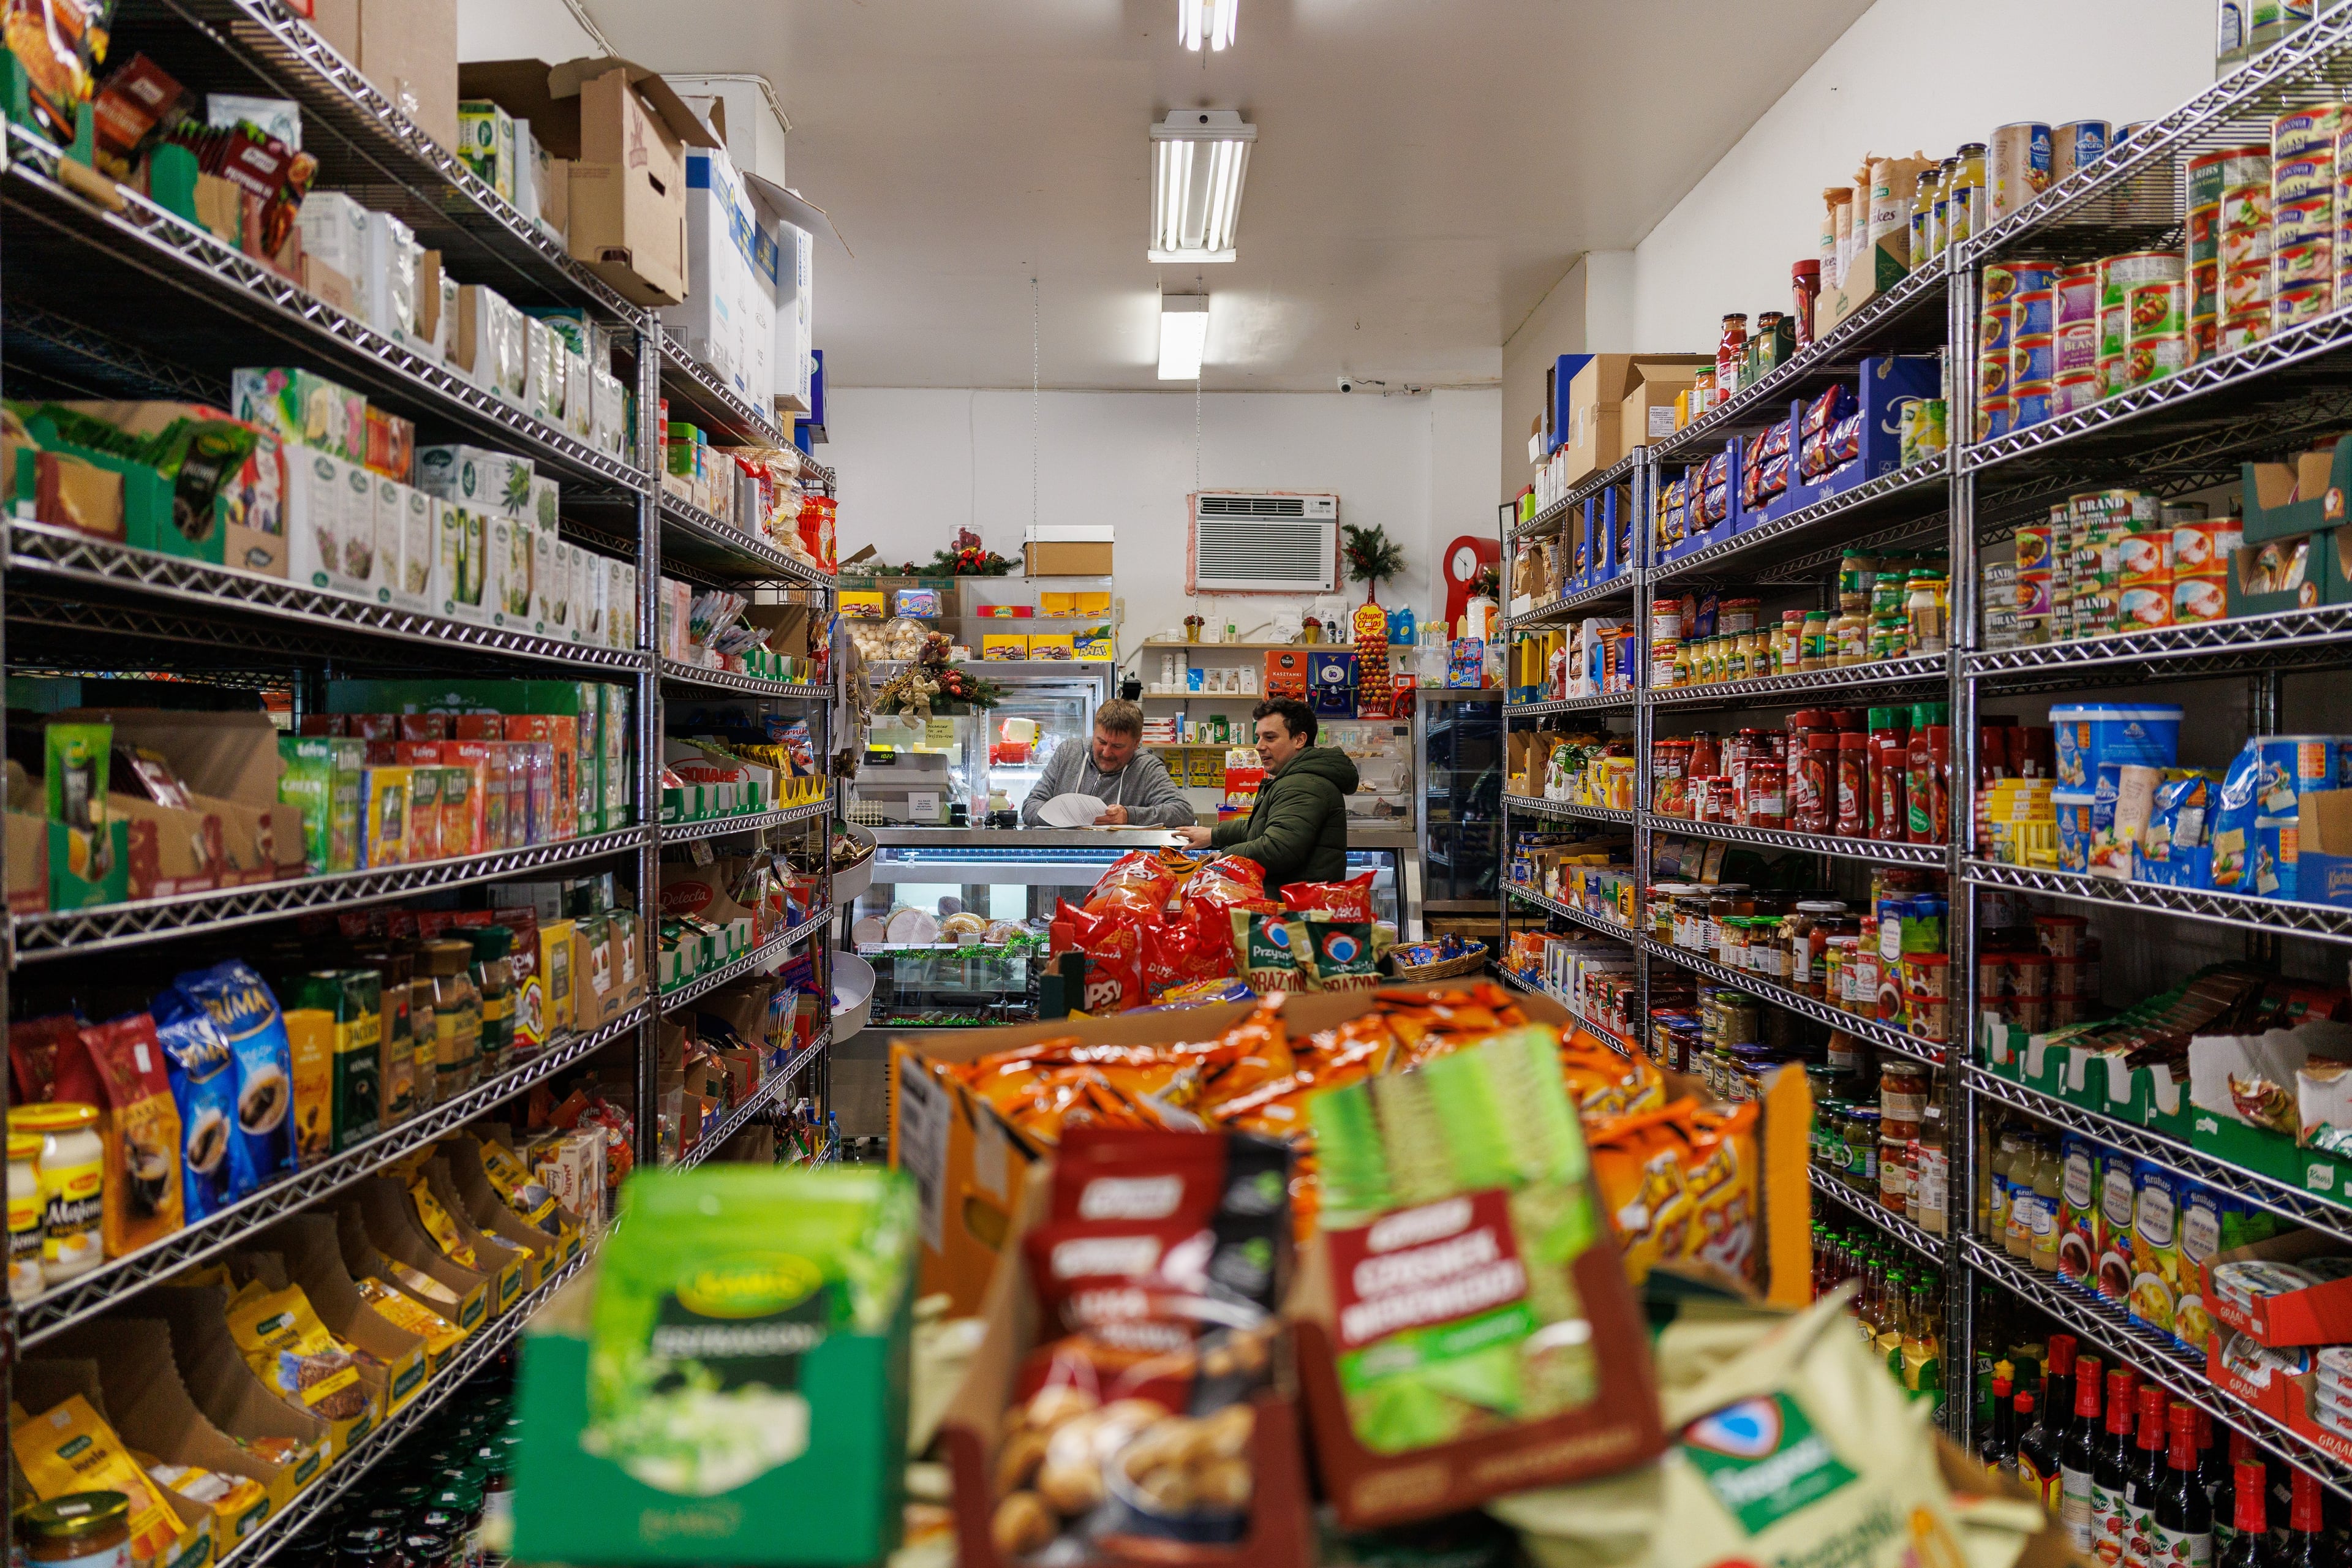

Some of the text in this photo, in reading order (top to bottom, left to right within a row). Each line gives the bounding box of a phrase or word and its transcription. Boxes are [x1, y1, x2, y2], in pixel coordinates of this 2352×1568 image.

[1358, 612, 1382, 624] Chupa
[1357, 620, 1382, 633] Chps
[1450, 675, 1472, 687] MELODY
[773, 727, 809, 738] Sernik
[662, 888, 709, 907] Delecta
[1651, 995, 1683, 1005] EKOLADA
[2220, 1306, 2244, 1324] GRAAL
[2229, 1378, 2258, 1397] GRAAL
